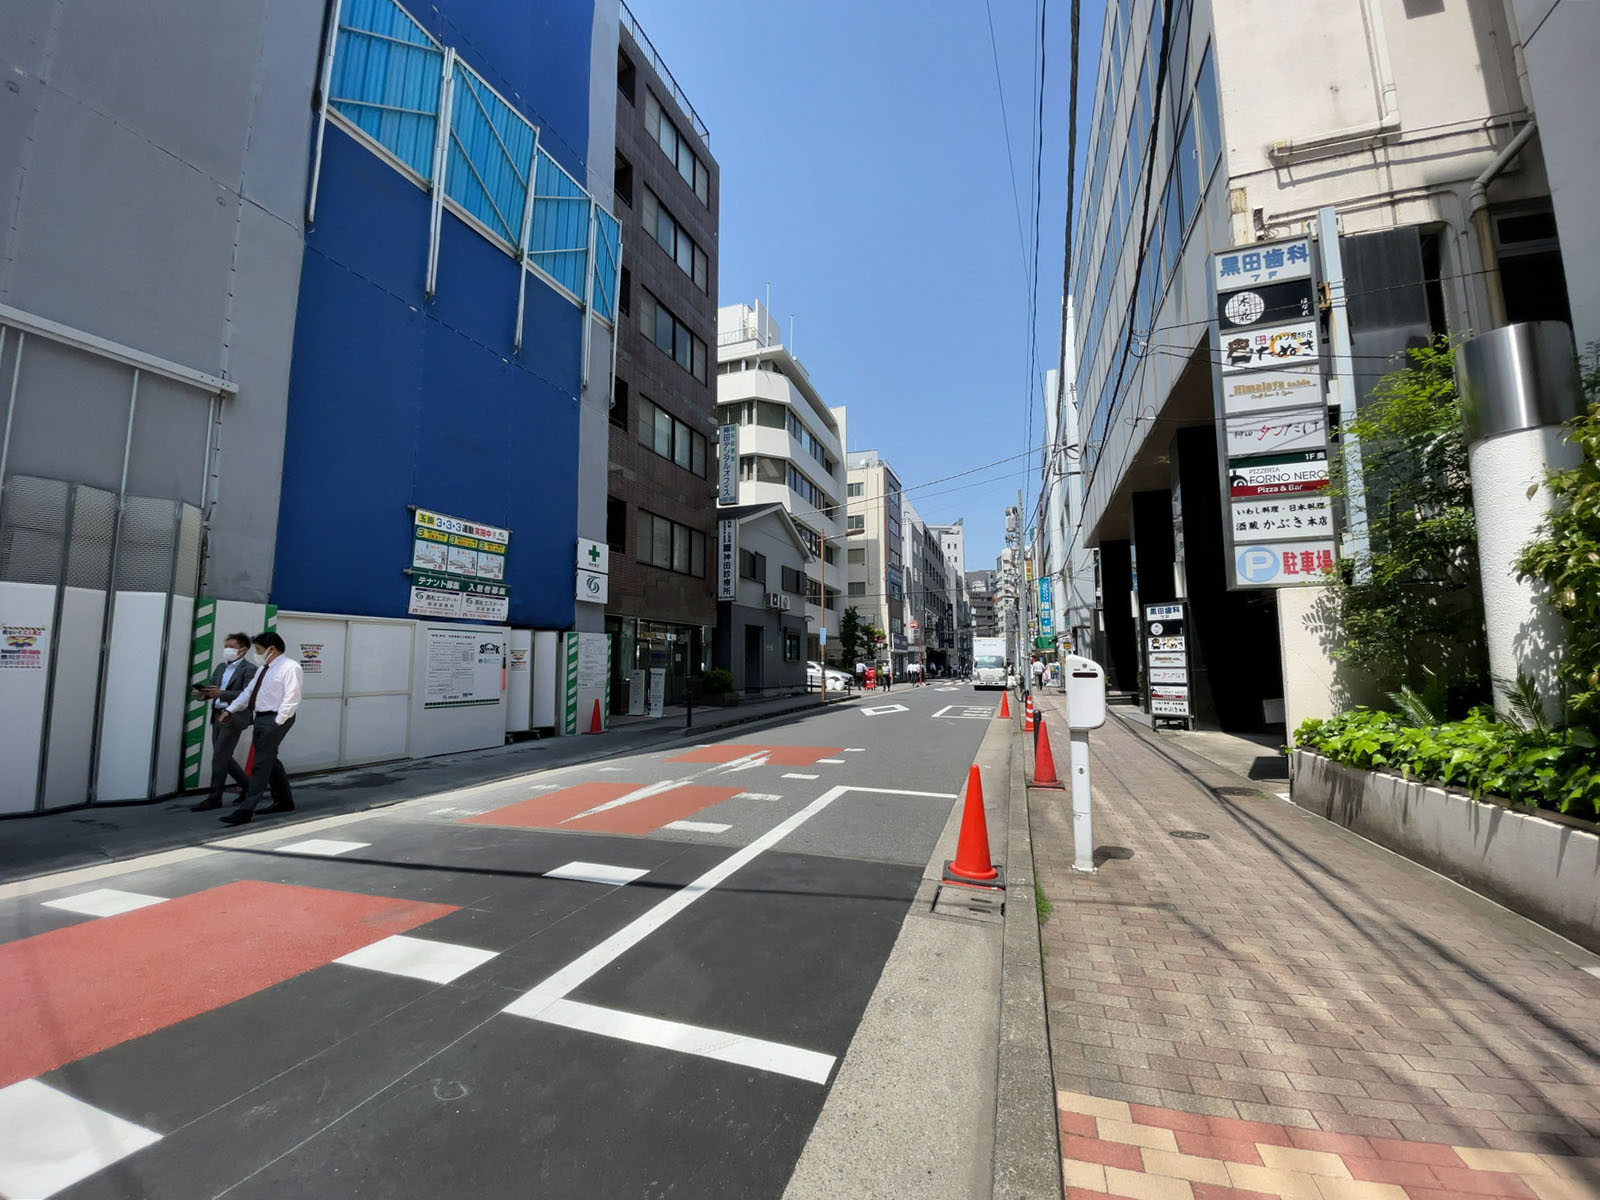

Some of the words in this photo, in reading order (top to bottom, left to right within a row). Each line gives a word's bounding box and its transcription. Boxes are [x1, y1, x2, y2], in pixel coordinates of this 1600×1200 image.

[1220, 243, 1309, 278] 黒田歯科
[1233, 382, 1285, 396] Himalaya
[1249, 467, 1280, 475] PIZZERIA
[1249, 472, 1291, 485] FORNO
[1294, 469, 1328, 481] NERO
[1257, 485, 1279, 493] Pizza
[1288, 483, 1303, 491] Bar
[1245, 551, 1274, 579] P
[1282, 549, 1334, 575] 駐車場
[418, 576, 460, 590] テナント募集
[1150, 606, 1180, 615] 黒田歯科
